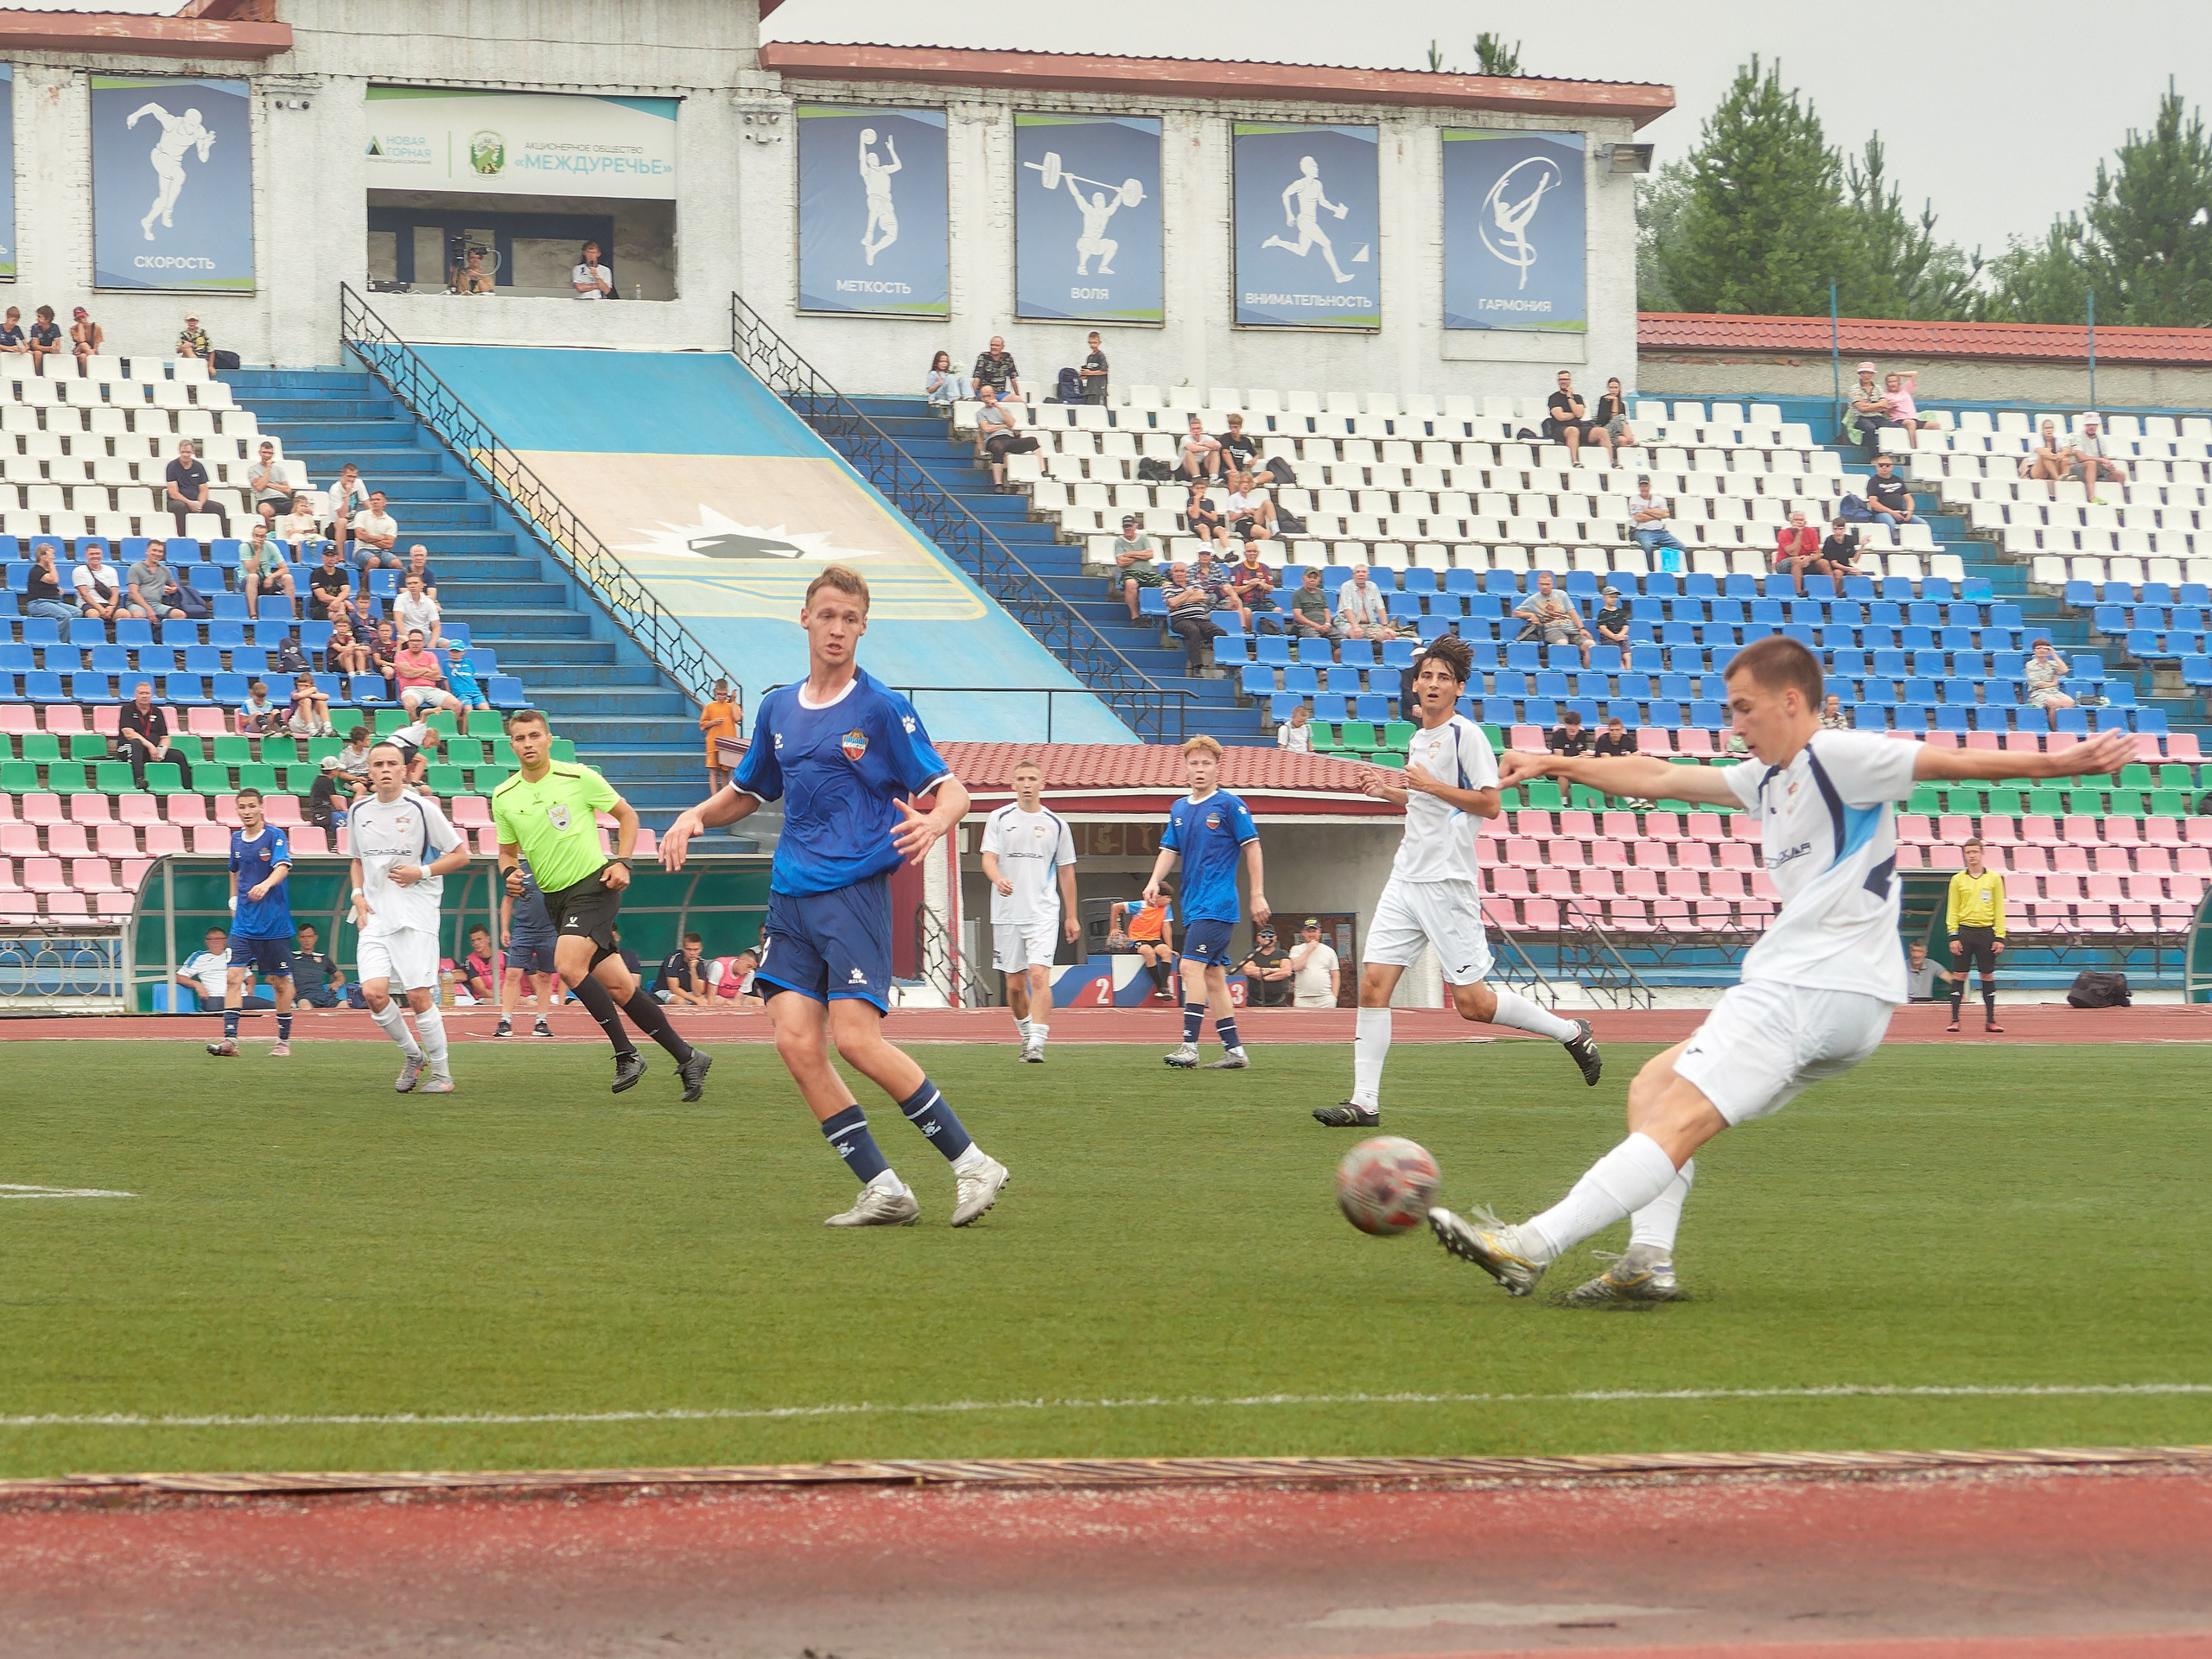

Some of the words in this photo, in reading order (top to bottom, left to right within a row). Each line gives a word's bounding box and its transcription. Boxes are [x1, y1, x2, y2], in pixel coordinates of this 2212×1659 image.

[386, 136, 427, 145] НОВАЯ
[386, 147, 432, 157] ГОРНАЯ
[524, 142, 592, 152] АКЦИОНЕРНОЕ
[593, 144, 644, 155] ОБЩЕСТВО
[514, 154, 673, 175] «МЕЖДУРЕЧЬЕ»
[133, 255, 216, 270] СКОРОСТЬ
[836, 279, 912, 295] МЕТКОСТЬ
[1071, 287, 1109, 300] ВОЛЯ
[1244, 292, 1374, 308] ВНИМАТЕЛЬНОСТЬ
[1478, 298, 1553, 312] ГАРМОНИЯ
[1096, 978, 1110, 1004] 2
[1231, 983, 1244, 1005] 3
